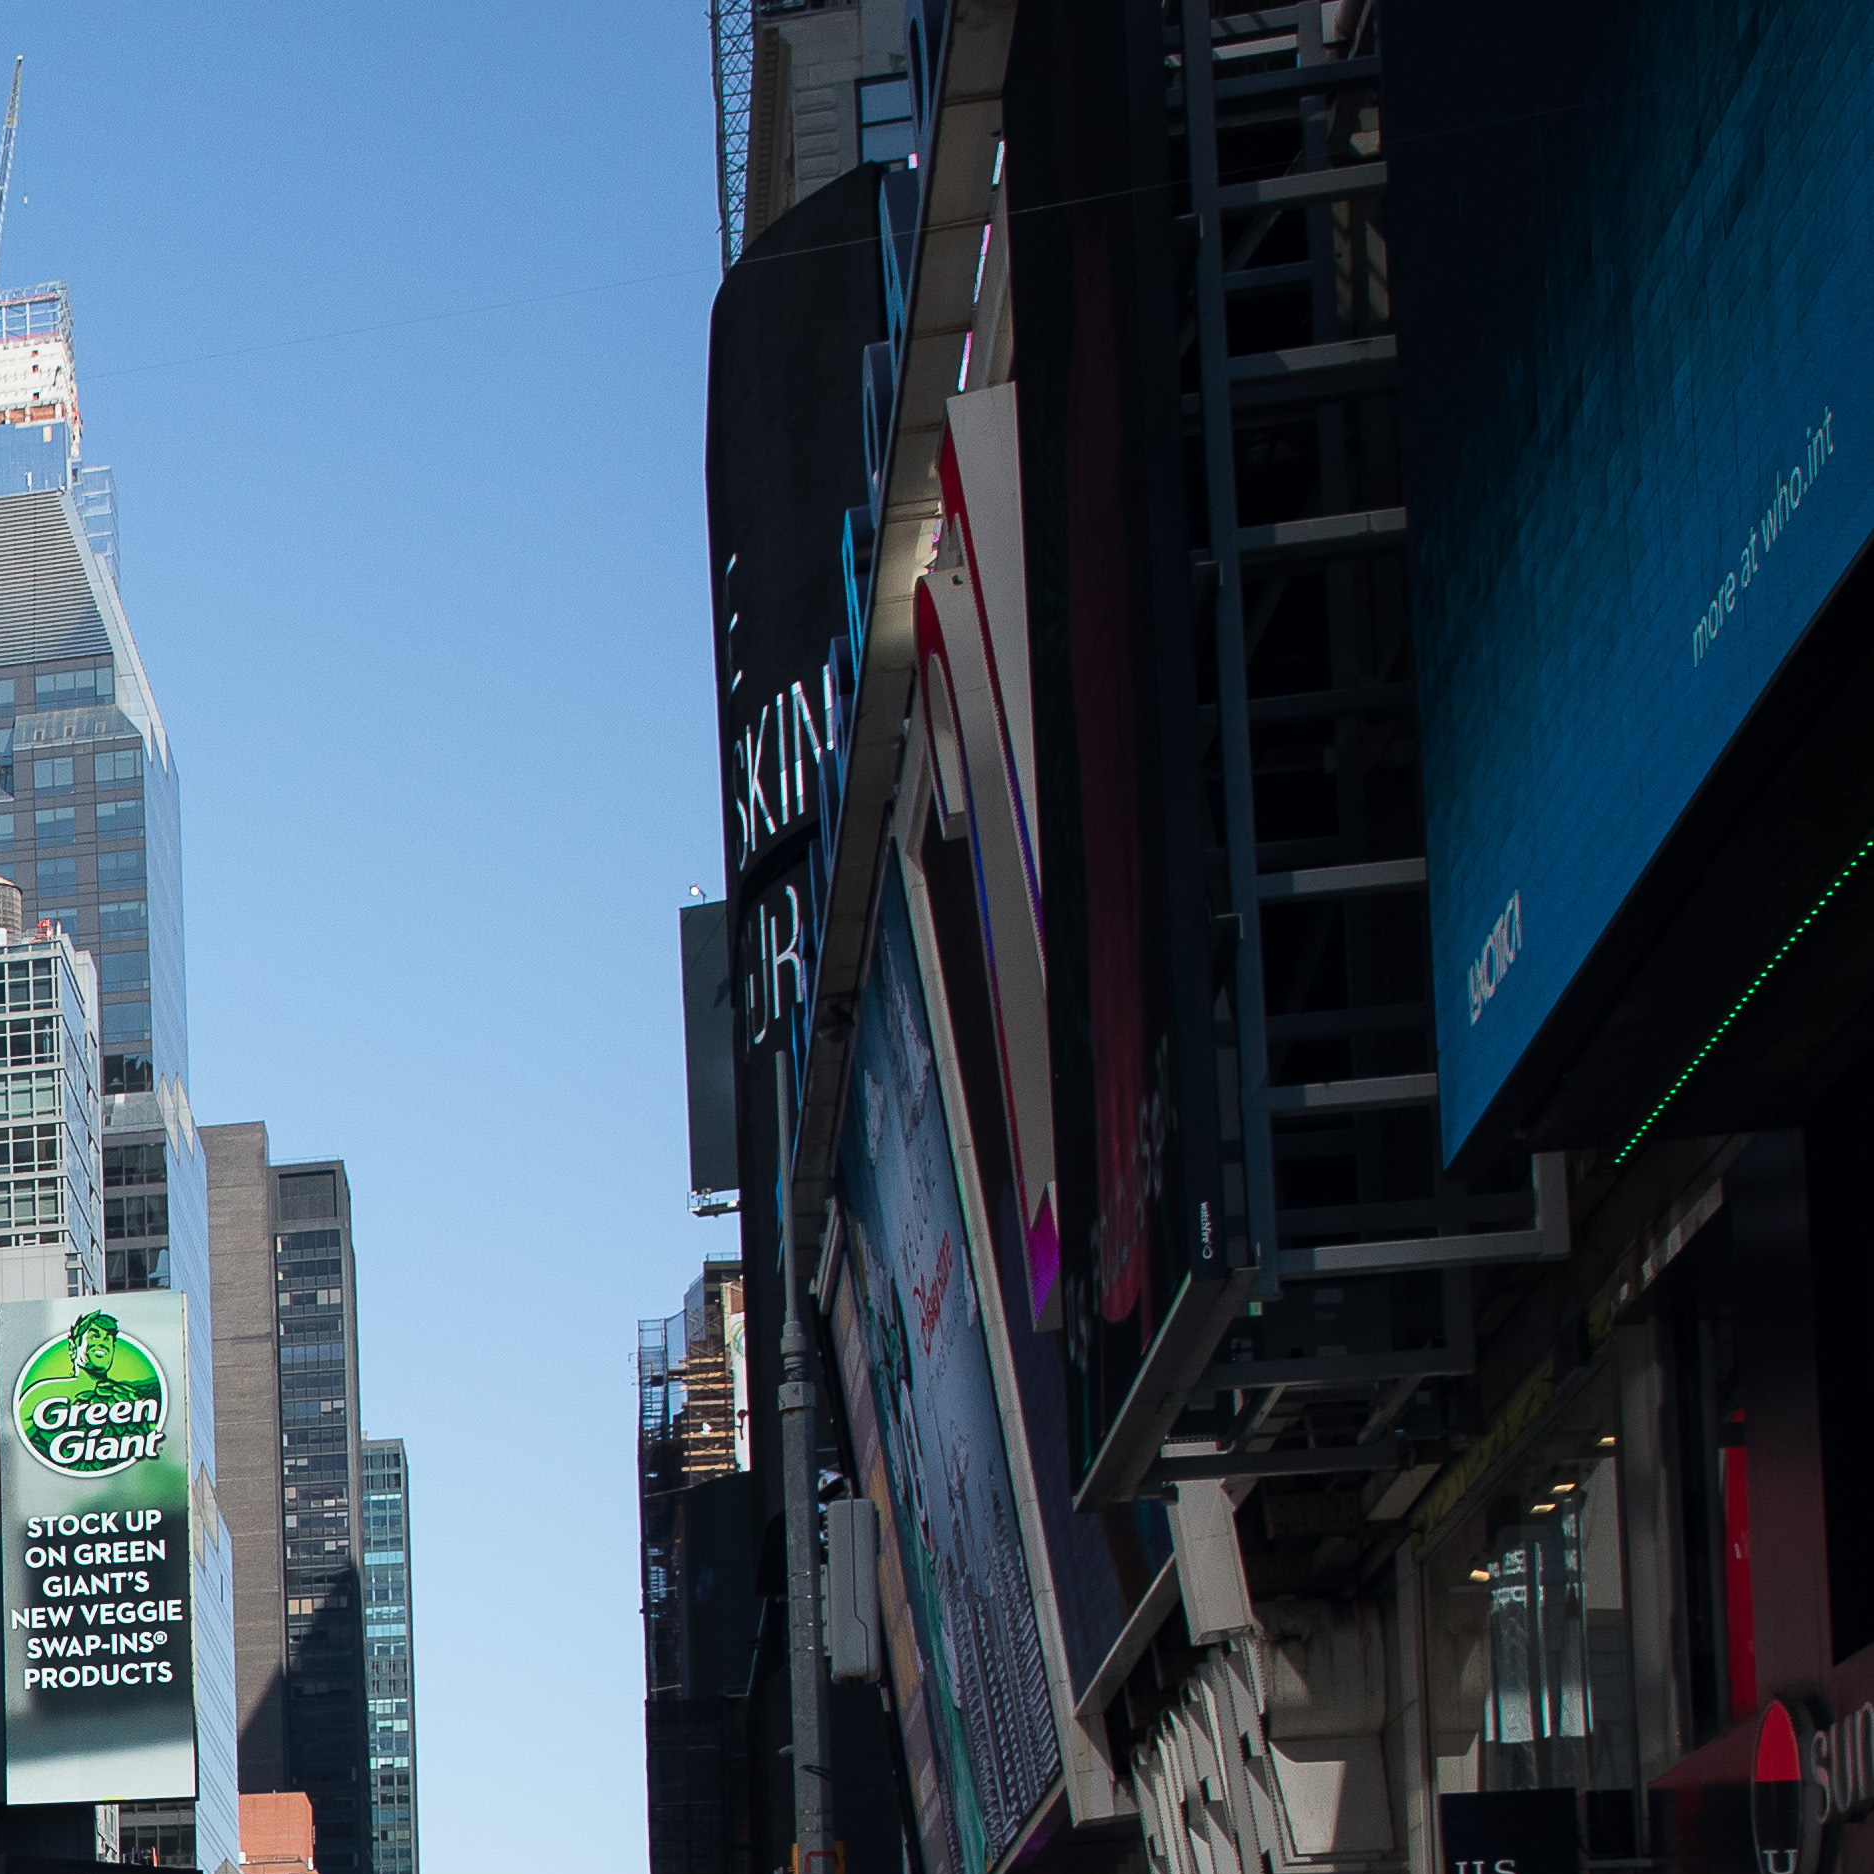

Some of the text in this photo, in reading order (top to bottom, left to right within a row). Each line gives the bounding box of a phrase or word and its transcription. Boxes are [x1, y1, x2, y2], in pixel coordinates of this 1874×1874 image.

[1692, 405, 1835, 668] more at who.int
[32, 1397, 158, 1432] Green
[48, 1426, 165, 1463] Giant
[26, 1509, 163, 1539] STOCK UP
[24, 1539, 166, 1569] ON GREEN
[41, 1570, 151, 1598] GIANT'S
[10, 1599, 184, 1632] NEW VEGGIE
[23, 1661, 174, 1690] PRODUCTS
